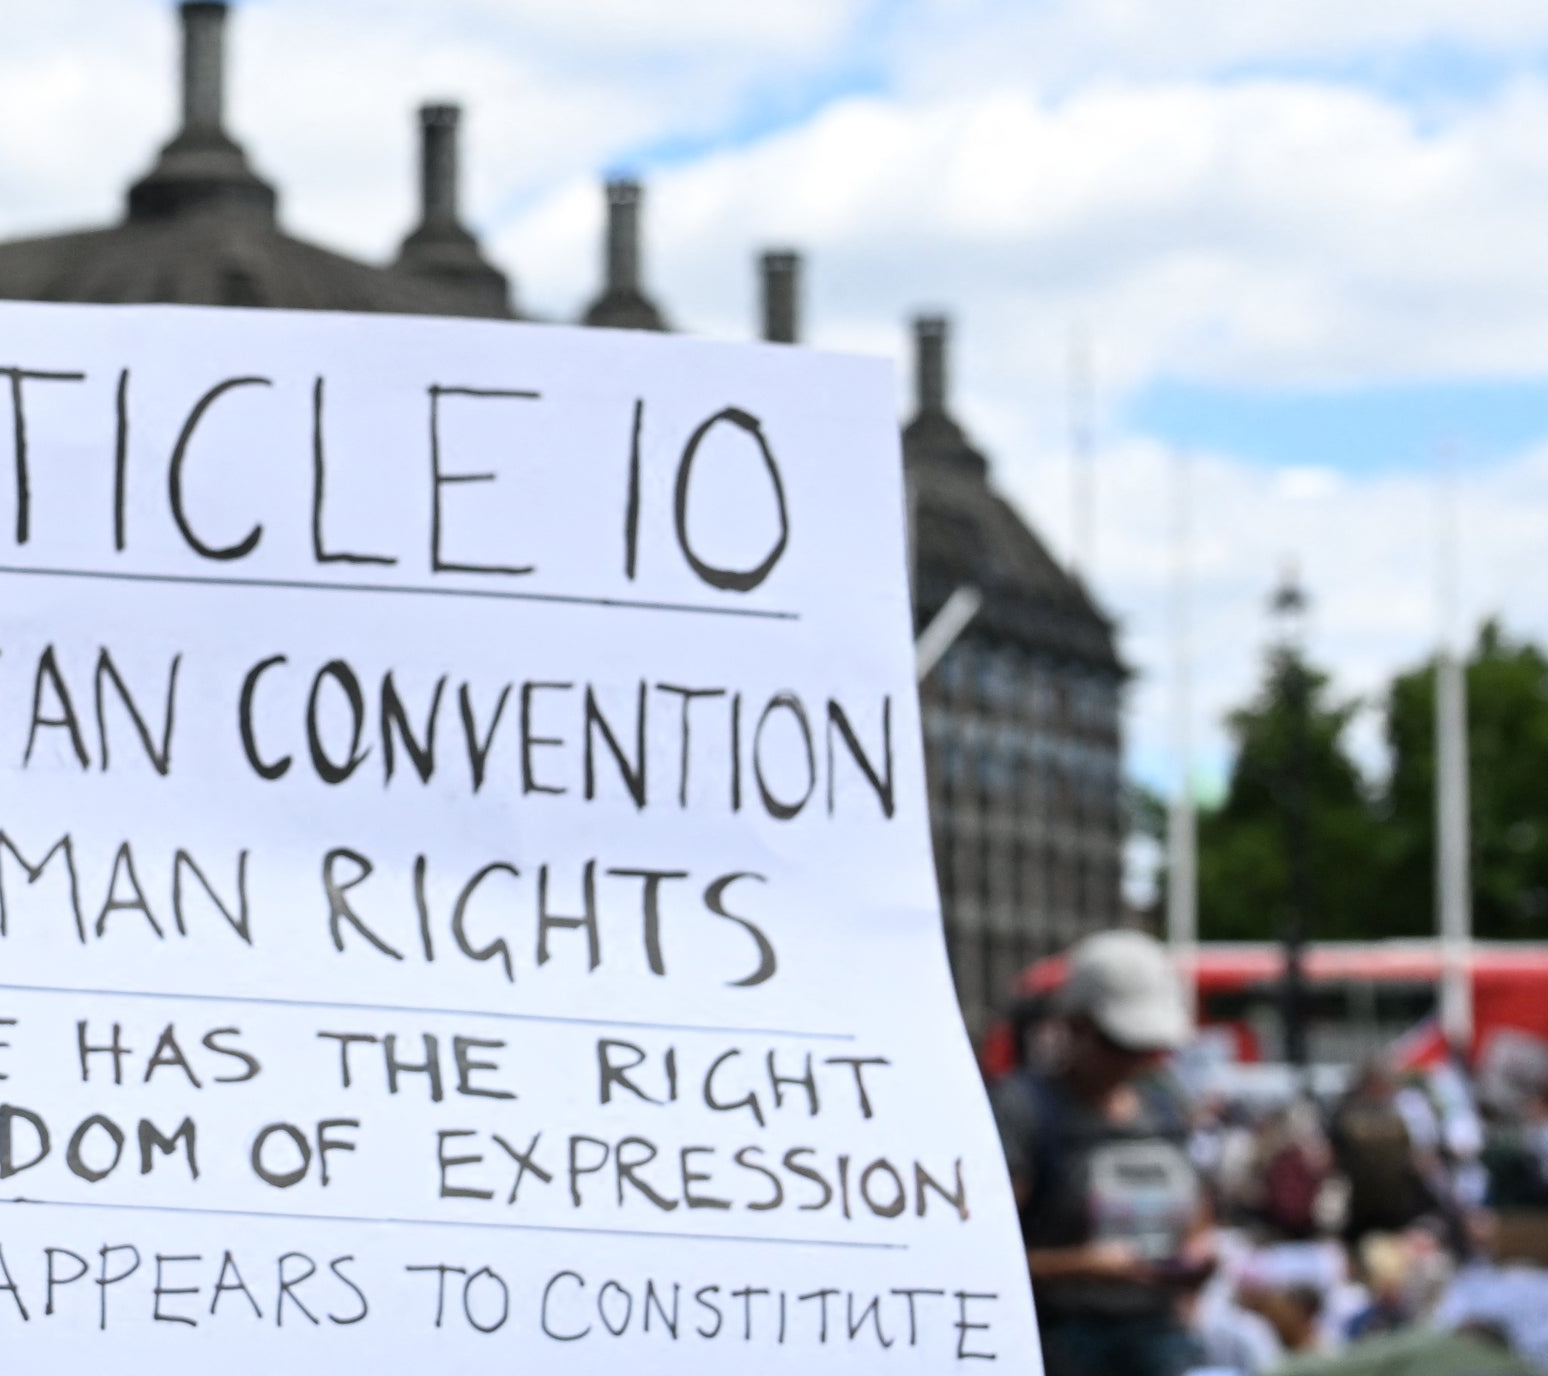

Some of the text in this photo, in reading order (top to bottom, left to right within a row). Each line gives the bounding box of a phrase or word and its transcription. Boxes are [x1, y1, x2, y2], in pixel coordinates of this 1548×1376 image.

[624, 398, 790, 594] 10
[238, 654, 895, 821] CONVENTION
[322, 847, 777, 987] RIGHTS
[77, 1020, 261, 1089] HAS
[317, 1031, 518, 1103] THE
[596, 1038, 890, 1128] RIGHT
[250, 1118, 360, 1189] OF
[437, 1129, 969, 1221] EXPRESSION
[405, 1264, 509, 1334] TO
[541, 1270, 998, 1360] CONSTITUTE
